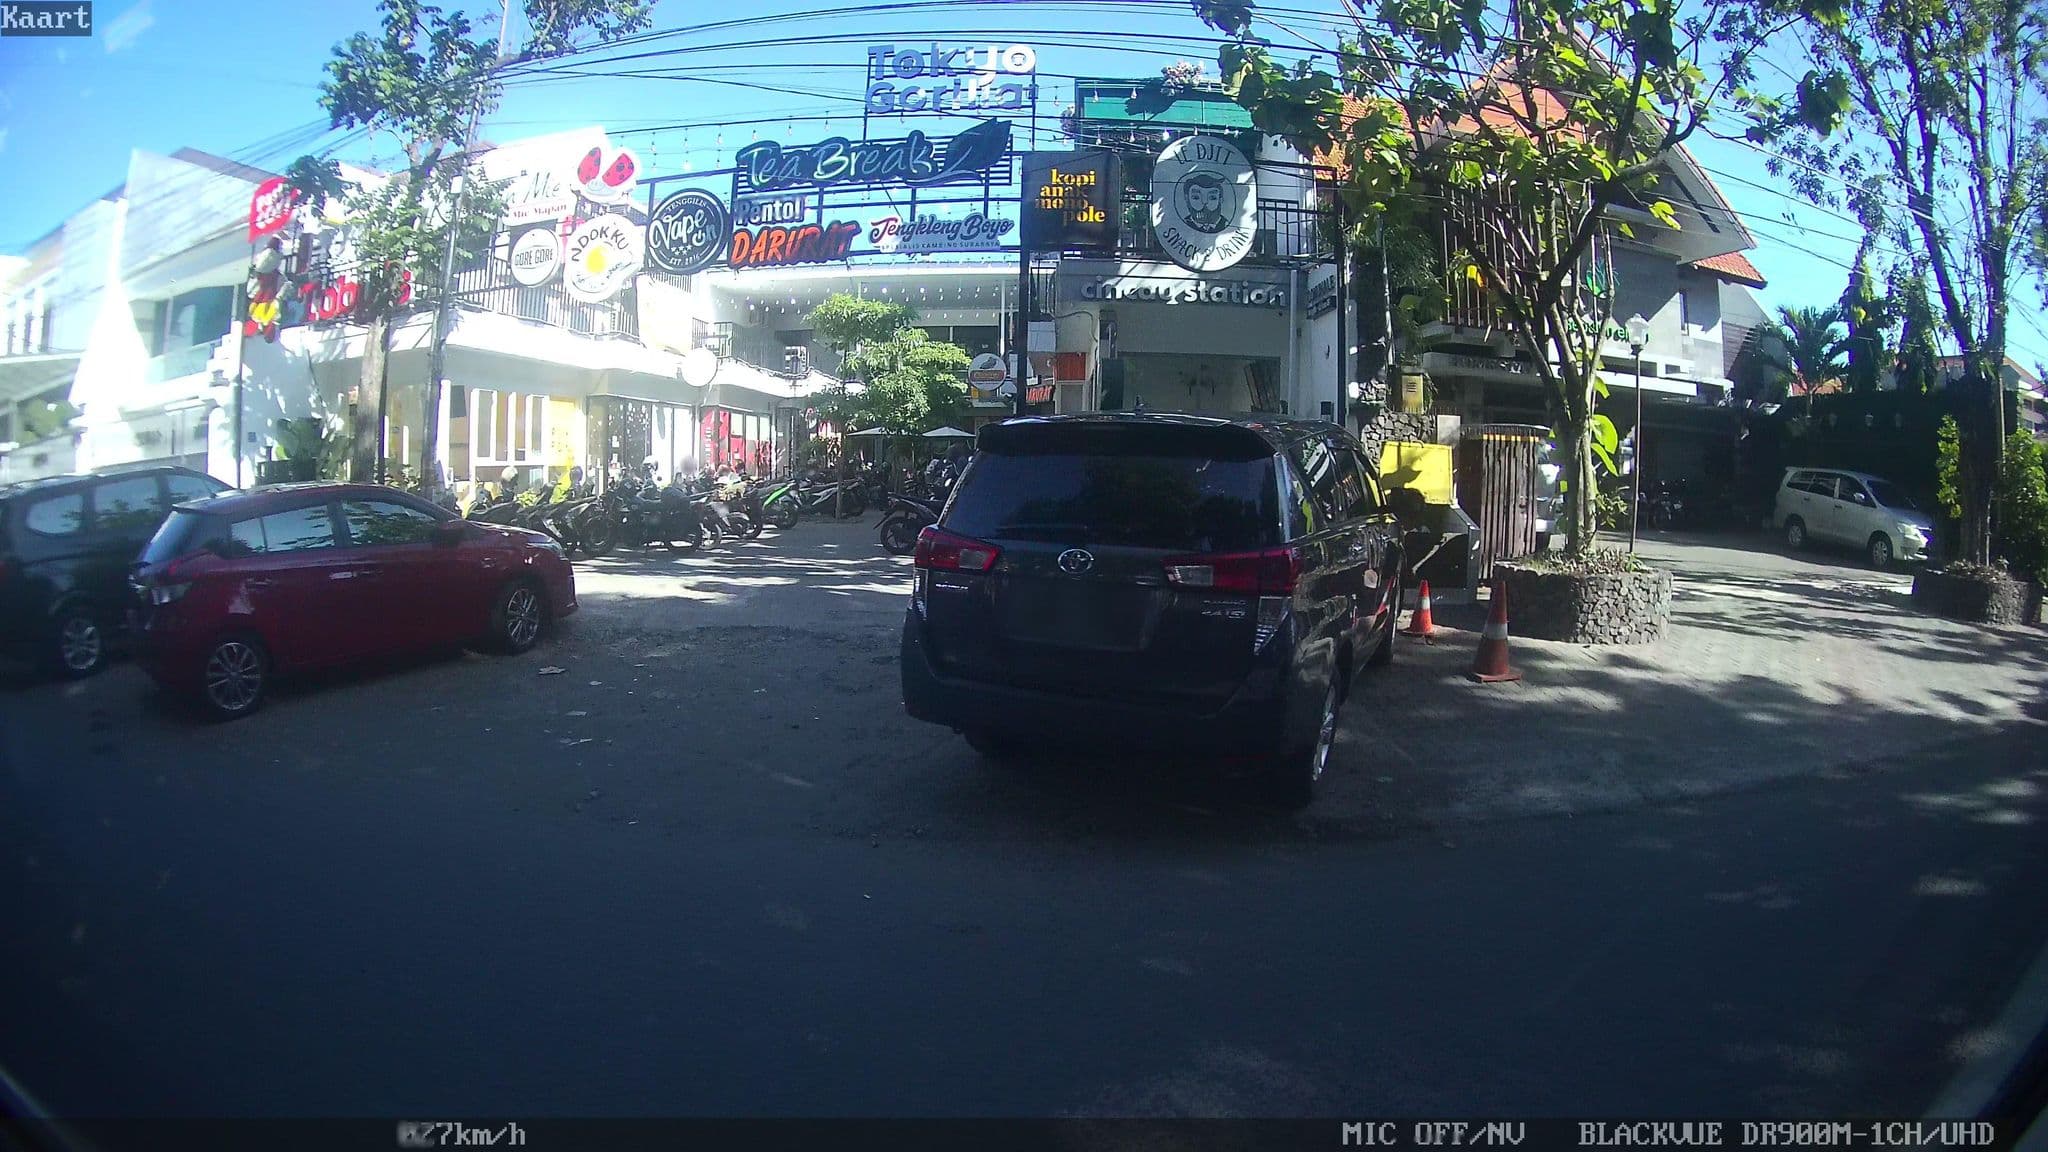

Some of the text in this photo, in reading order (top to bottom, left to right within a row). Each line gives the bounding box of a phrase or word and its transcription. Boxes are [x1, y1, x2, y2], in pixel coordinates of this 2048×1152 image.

[867, 42, 1036, 87] Tokyo
[865, 79, 1023, 113] Gorilla
[739, 135, 933, 187] Tea Break
[1040, 185, 1088, 197] anak
[1051, 168, 1095, 187] kopi
[735, 198, 802, 226] Pentol
[959, 212, 1015, 241] Boyo
[1063, 206, 1105, 226] pole
[649, 208, 707, 250] Vape
[730, 221, 859, 264] DARURAT
[1216, 228, 1249, 260] DRINK
[1184, 281, 1287, 307] station
